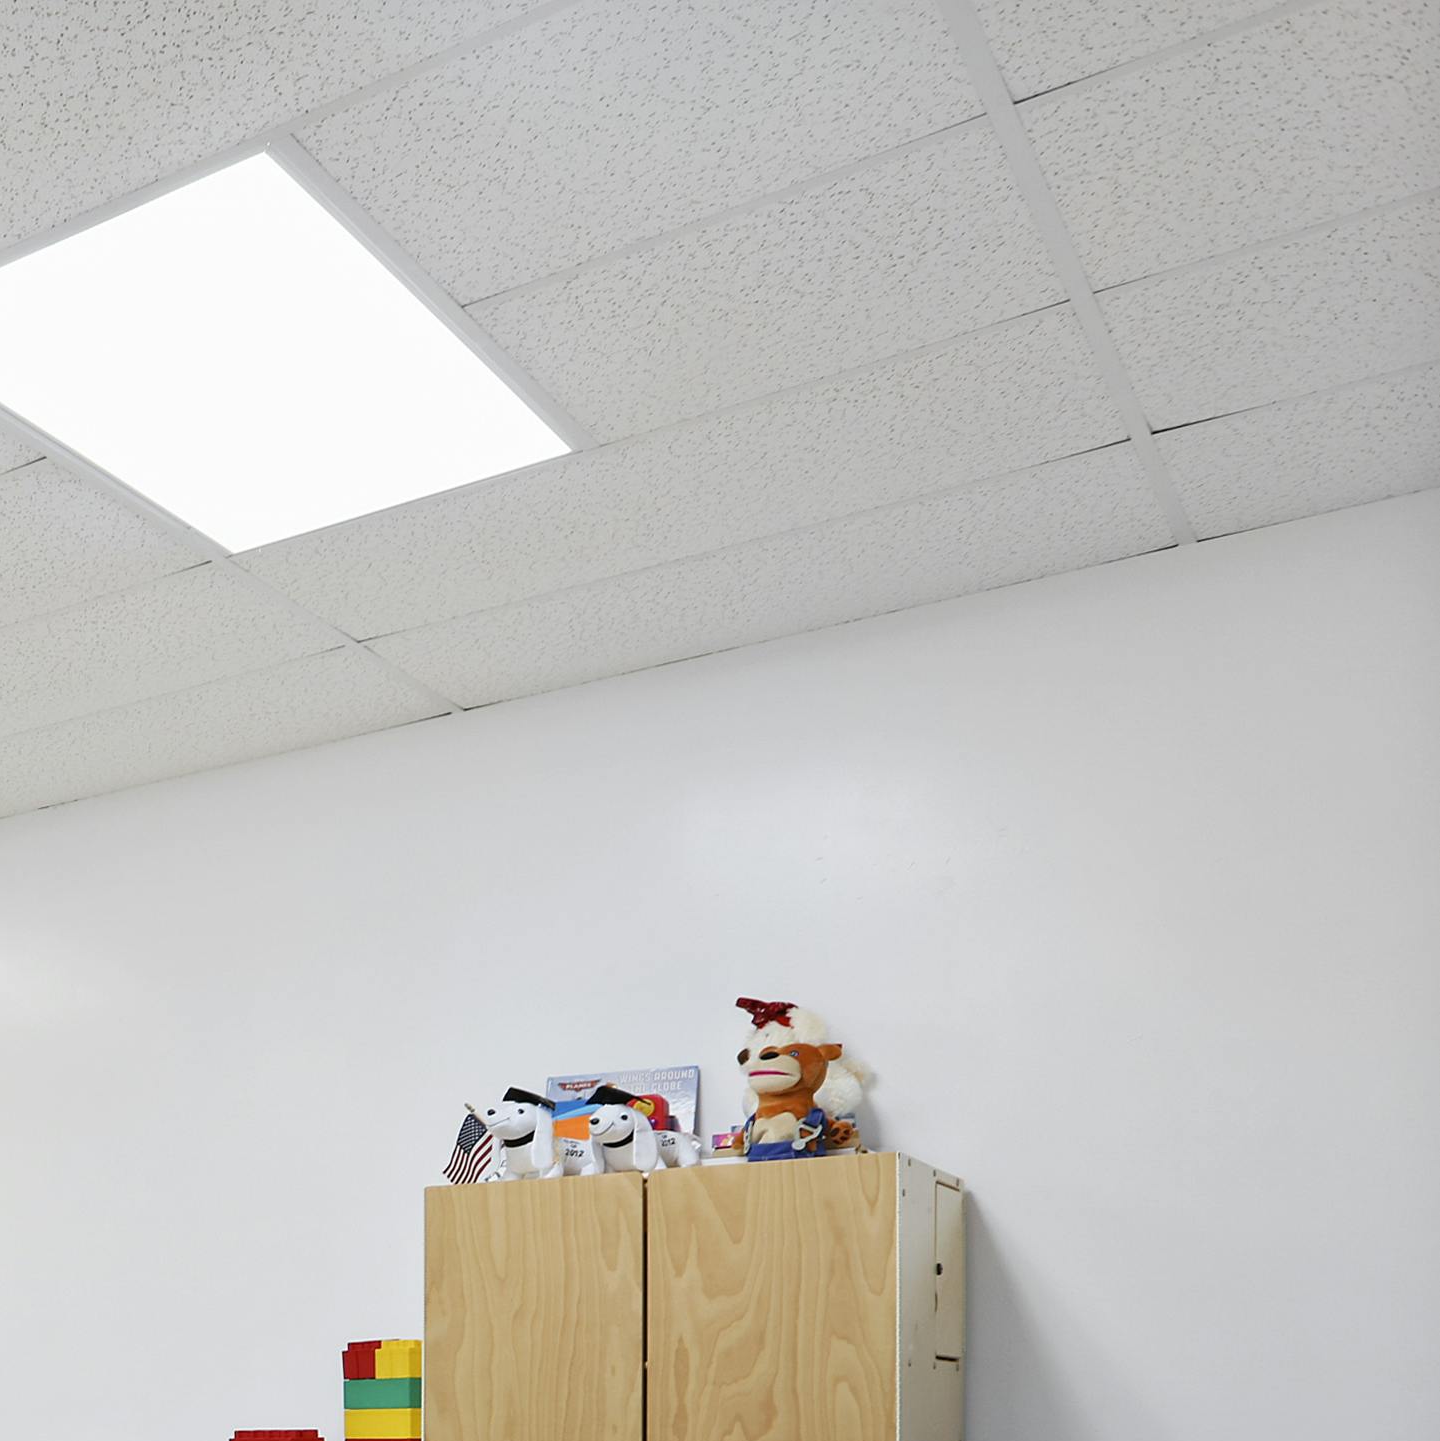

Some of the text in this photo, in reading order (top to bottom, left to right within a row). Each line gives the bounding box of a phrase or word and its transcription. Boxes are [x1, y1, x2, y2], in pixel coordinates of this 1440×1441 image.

[621, 1068, 695, 1083] WINGS AROUND
[652, 1081, 682, 1091] GLOBE
[565, 1149, 585, 1158] 2012
